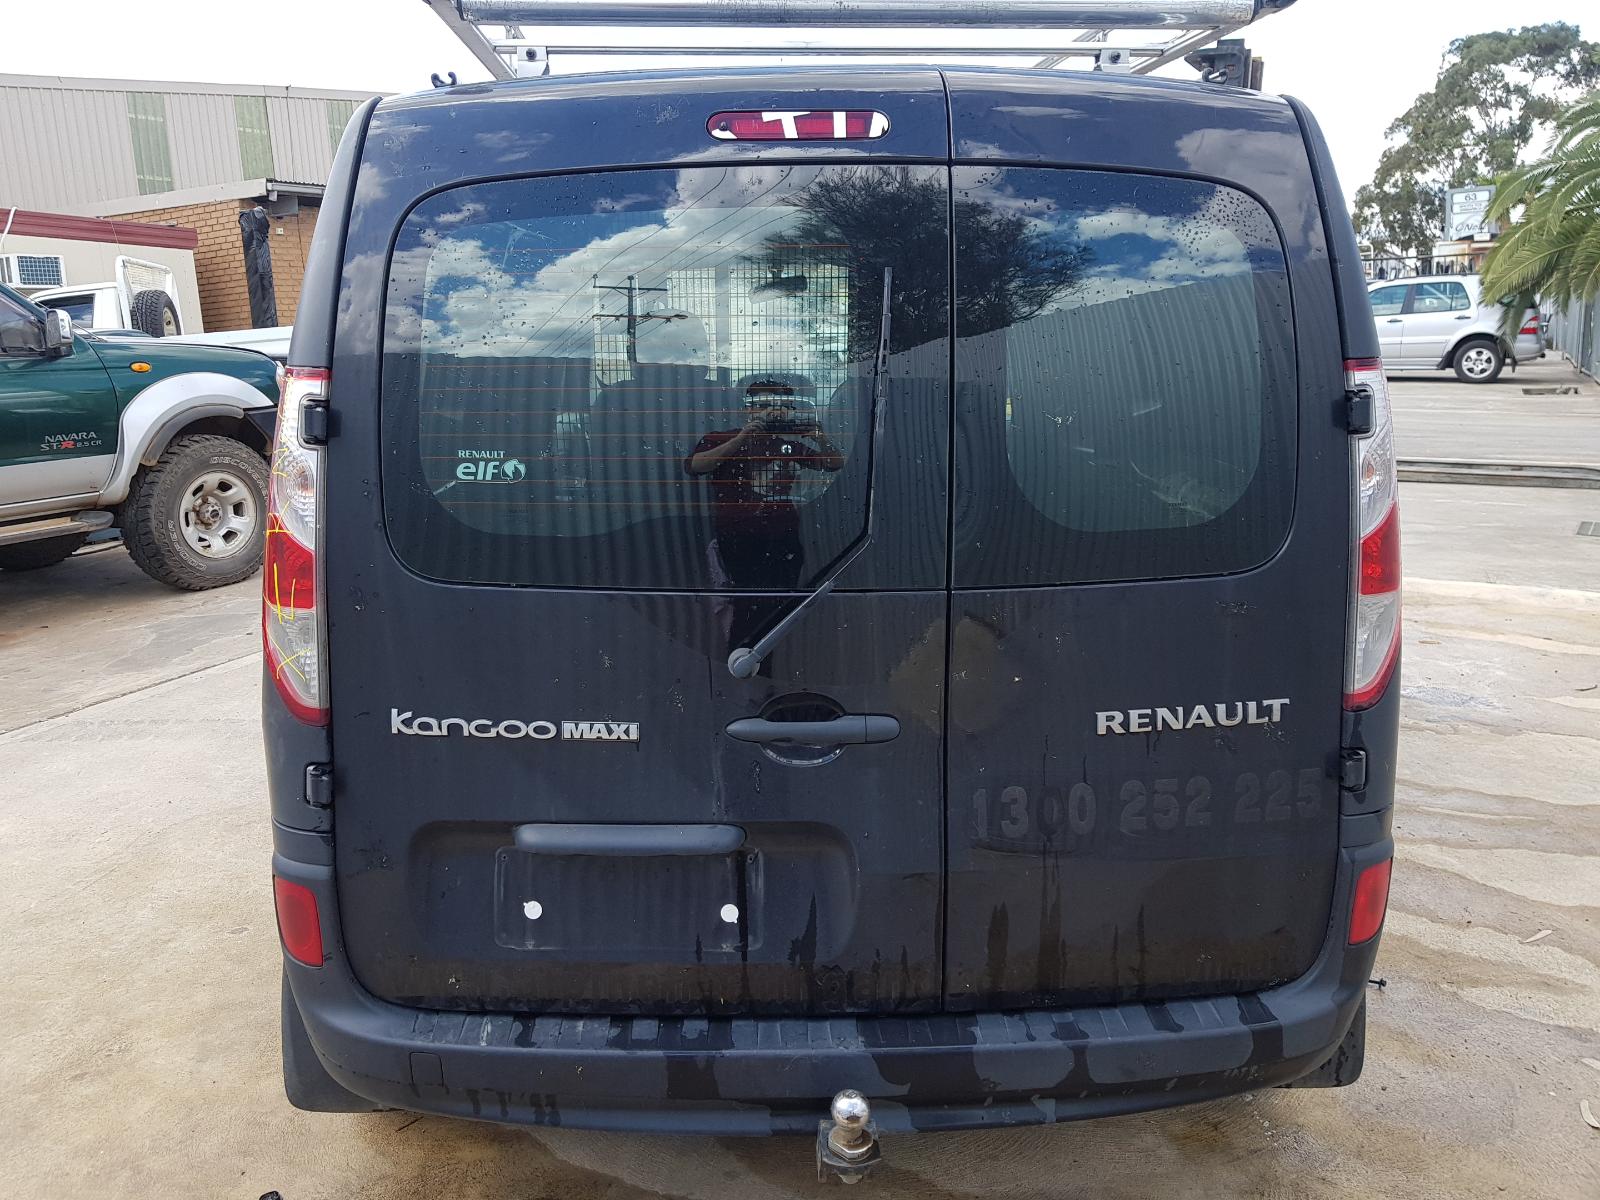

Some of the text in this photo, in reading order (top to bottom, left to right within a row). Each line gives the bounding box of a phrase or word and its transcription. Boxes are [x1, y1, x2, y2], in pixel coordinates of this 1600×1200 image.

[44, 431, 97, 443] NAVARA
[457, 449, 505, 459] RENAULT
[456, 461, 500, 480] elf
[1095, 698, 1290, 735] RENAULT
[562, 722, 639, 741] MAXI
[972, 767, 1321, 839] 1300 252 225
